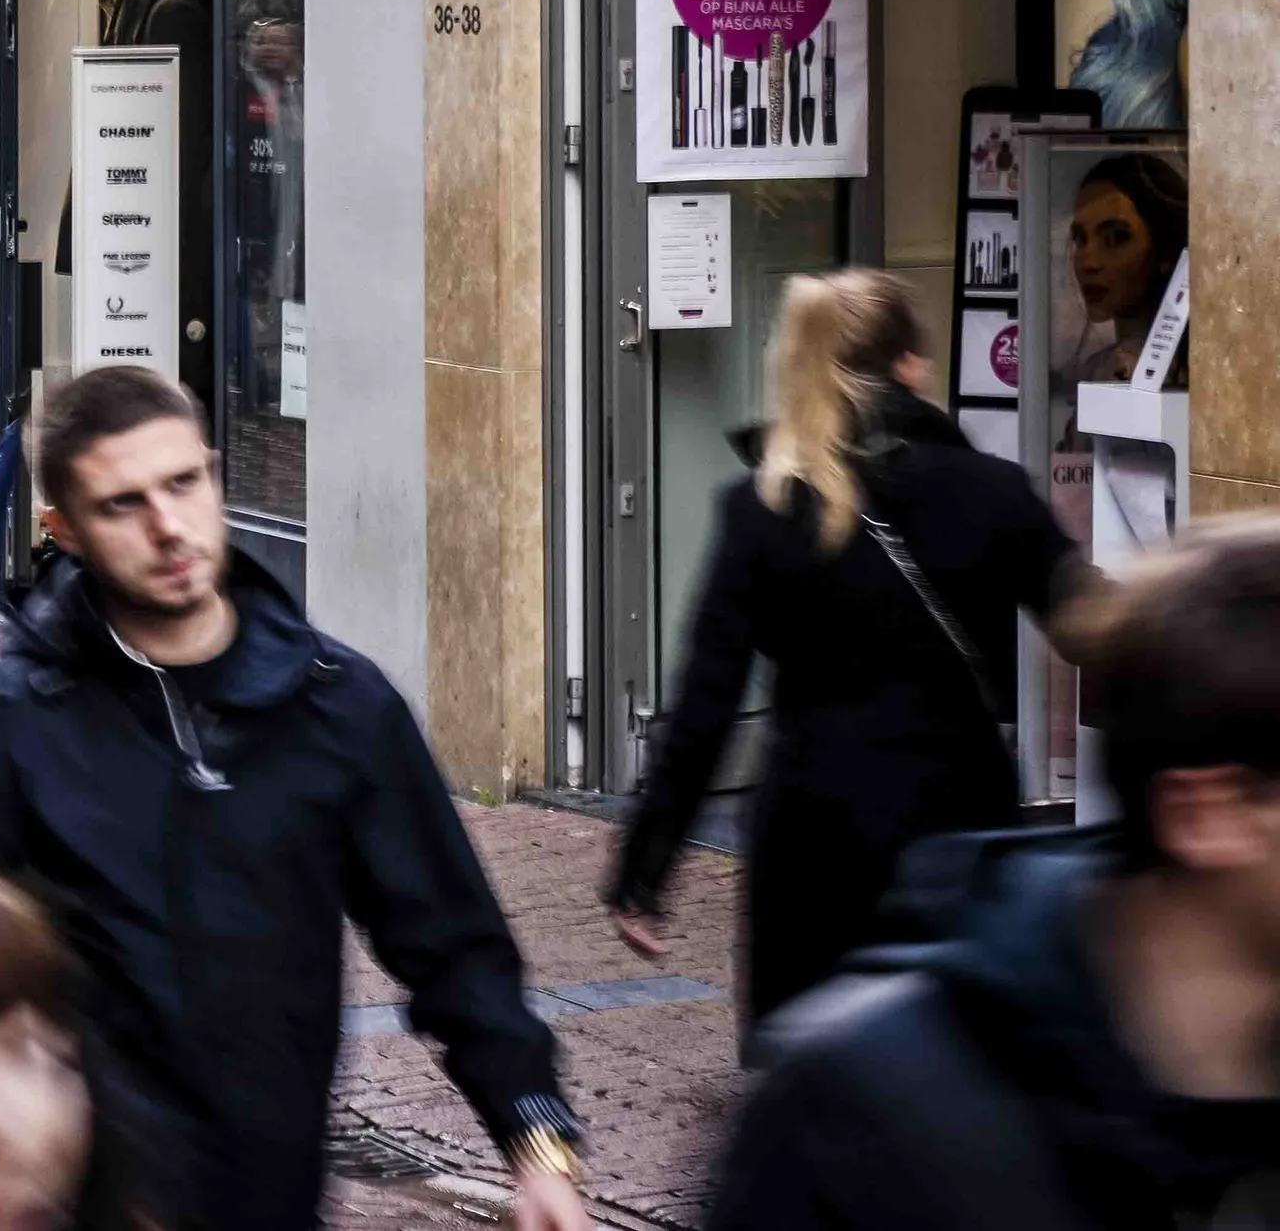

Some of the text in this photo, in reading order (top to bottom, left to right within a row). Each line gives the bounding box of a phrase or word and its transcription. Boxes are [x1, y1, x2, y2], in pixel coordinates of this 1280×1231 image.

[700, 0, 721, 15] OP
[723, 0, 766, 14] BIJNA
[433, 5, 482, 36] 36-38
[711, 17, 794, 31] MASCARA'S
[99, 127, 155, 139] CHASIN'
[105, 168, 148, 179] TOMMY
[100, 347, 153, 357] DIESEL
